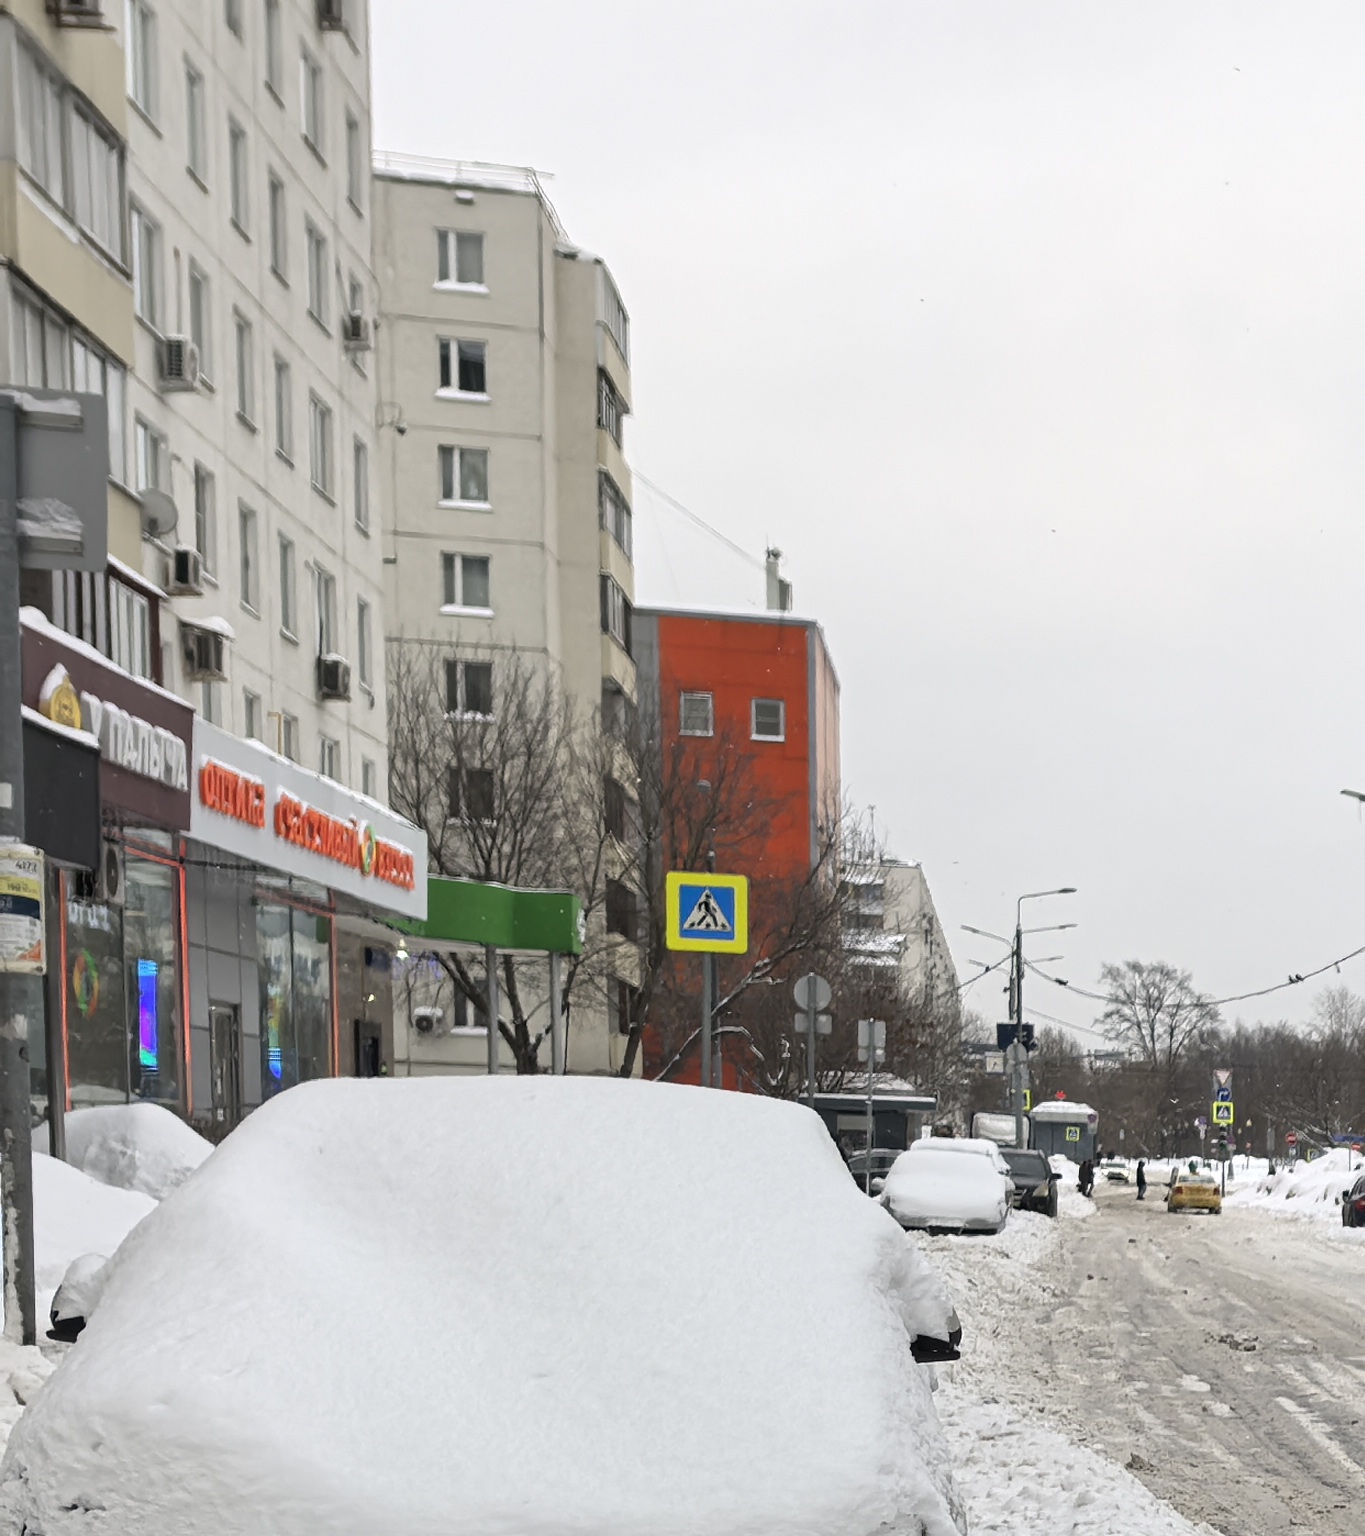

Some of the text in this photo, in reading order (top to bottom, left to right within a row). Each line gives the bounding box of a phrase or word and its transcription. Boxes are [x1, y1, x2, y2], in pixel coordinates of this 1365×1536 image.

[80, 691, 188, 792] У ПАЛЫЧА
[201, 758, 265, 829] ОПТИКА
